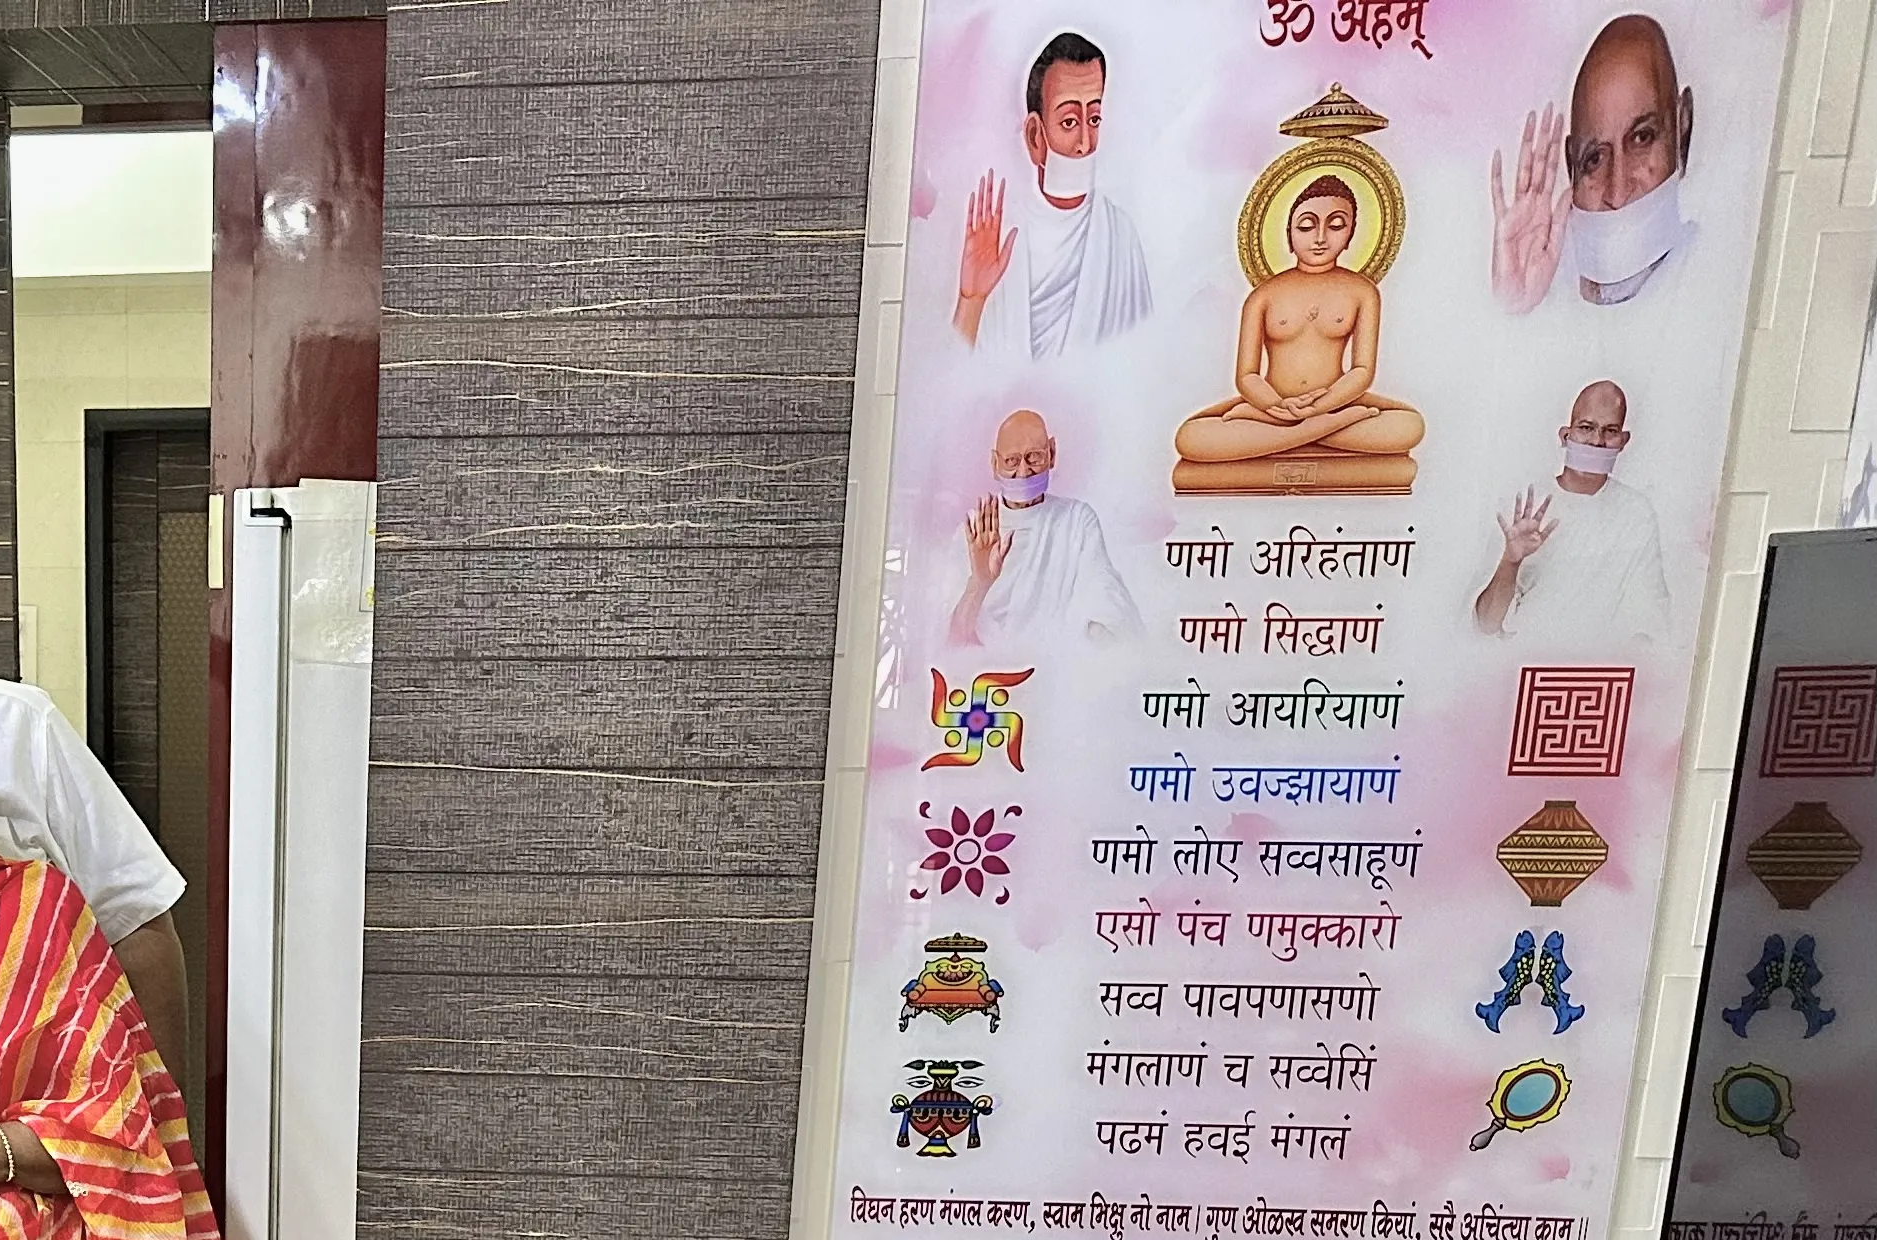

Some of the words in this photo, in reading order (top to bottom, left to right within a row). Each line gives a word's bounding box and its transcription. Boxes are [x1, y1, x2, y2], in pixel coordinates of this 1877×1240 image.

[1165, 525, 1234, 578] णमो
[1250, 525, 1416, 579] अरिहंताणं
[1180, 602, 1247, 654] णमो
[1264, 602, 1384, 656] सिद्धाणं
[1143, 677, 1210, 729] णमो
[1226, 678, 1405, 730] आयरियाणं
[1130, 752, 1196, 802] णमो
[1213, 755, 1401, 806] उवज्झायाणं
[1092, 825, 1158, 875] णमो
[1174, 825, 1243, 883] लोए
[1259, 828, 1423, 891] सव्वसाहूणं
[1096, 897, 1161, 953] एसो
[1177, 898, 1231, 947] पंच
[1247, 900, 1402, 961] णमुक्कारो
[1099, 983, 1168, 1017] सव्व
[1184, 972, 1381, 1021] पावपणासणो
[1087, 1039, 1208, 1086] मंगलाणं
[1224, 1055, 1254, 1088] च
[1269, 1042, 1377, 1091] सव्वेसिं
[1096, 1109, 1168, 1155] पढमं
[1184, 1110, 1255, 1164] हवई
[1270, 1112, 1352, 1160] मंगलं
[900, 1198, 936, 1229] हरण
[940, 1189, 983, 1228] मंगल
[1043, 1201, 1086, 1230] स्वाम
[1130, 1193, 1152, 1231] नो
[1310, 1209, 1367, 1239] समरण
